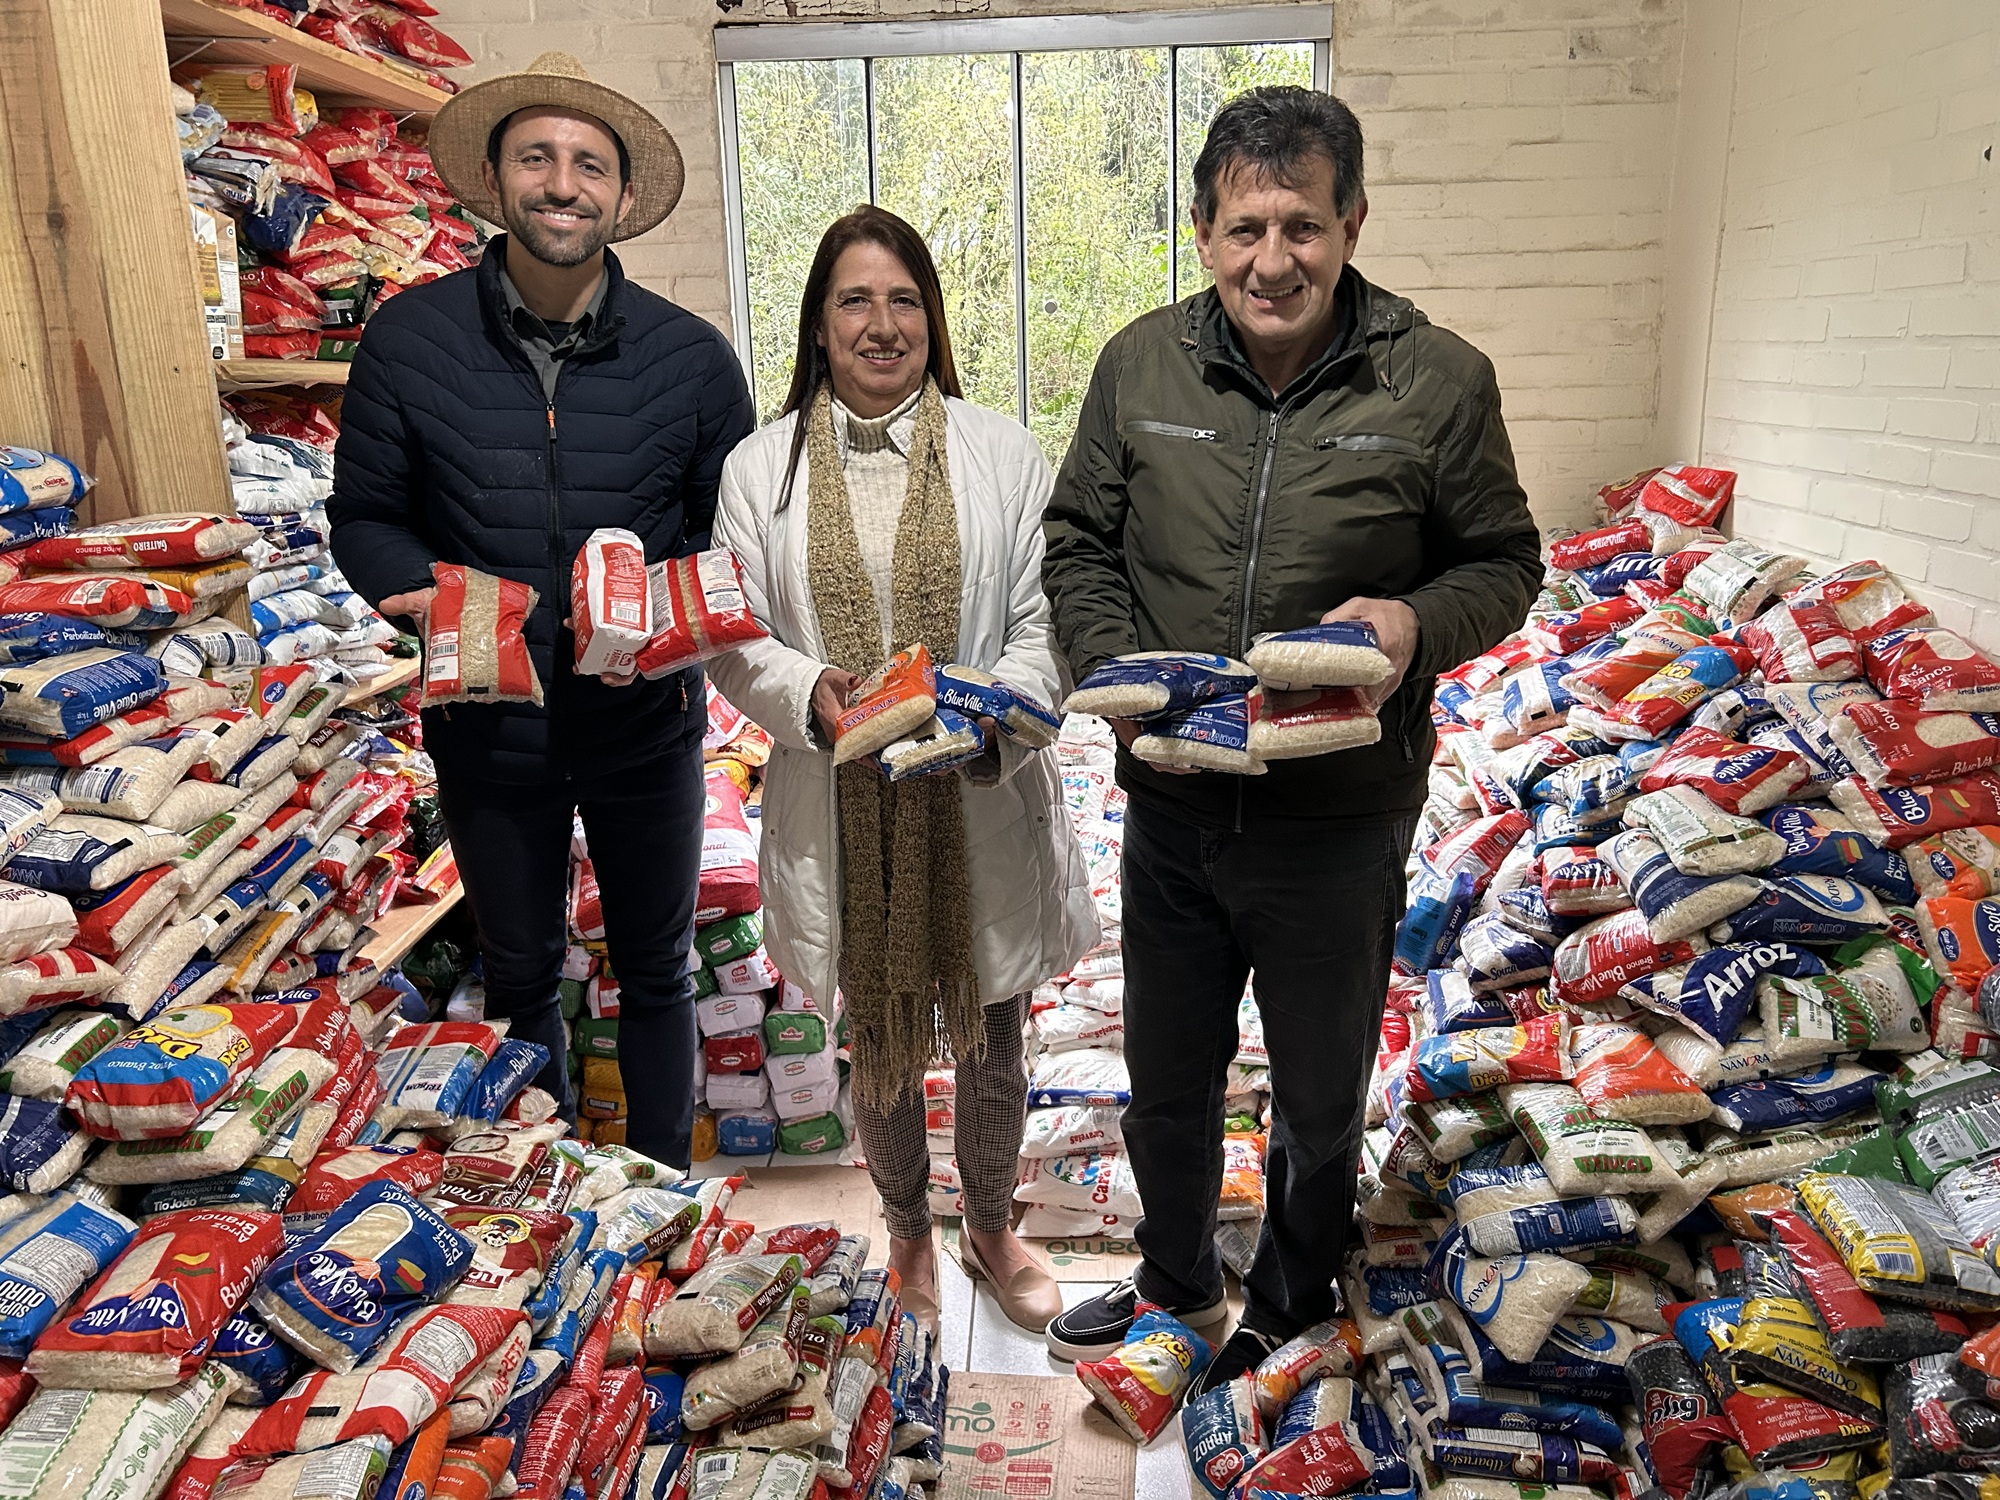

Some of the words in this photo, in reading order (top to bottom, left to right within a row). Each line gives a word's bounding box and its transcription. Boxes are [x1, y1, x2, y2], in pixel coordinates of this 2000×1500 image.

[133, 540, 167, 551] GAITEIRO
[63, 631, 105, 640] Parboilizado
[1677, 686, 1704, 704] Dica
[843, 695, 900, 729] NAMORADO
[1170, 724, 1241, 746] NAMORADO
[1884, 851, 1895, 878] Arroz
[1449, 905, 1462, 930] Arroz
[1772, 920, 1846, 934] NAMORADO
[1490, 964, 1519, 979] Souza
[1626, 956, 1653, 970] Branco
[1703, 942, 1797, 1013] Arroz
[255, 989, 312, 1002] ueVille
[1654, 991, 1681, 1012] Souza
[64, 1024, 115, 1068] TRIVIAL
[217, 1037, 250, 1068] Dica
[108, 1060, 148, 1071] Branco
[1471, 1073, 1508, 1089] Dica
[466, 1158, 493, 1169] ARROZ
[1578, 1155, 1649, 1173] TRIVIAL
[218, 1178, 250, 1187] POLIDO
[212, 1222, 250, 1243] Arroz
[379, 1190, 462, 1260] Parboilizado
[432, 1234, 454, 1266] Arroz
[1463, 1253, 1512, 1312] AMORADO
[1706, 1301, 1740, 1315] Feijão
[1529, 1364, 1600, 1378] NAMORADO
[1774, 1346, 1859, 1392] NAMORADO
[789, 1409, 812, 1418] BRANCO
[1119, 1400, 1138, 1422] Dica
[1777, 1431, 1798, 1442] Feijão
[1799, 1426, 1820, 1437] Preto
[1838, 1423, 1871, 1437] Dica
[1192, 1431, 1233, 1462] ARROZ
[1736, 1429, 1750, 1450] Preto
[1443, 1453, 1512, 1472] Albaruska
[186, 1477, 206, 1488] Tipo
